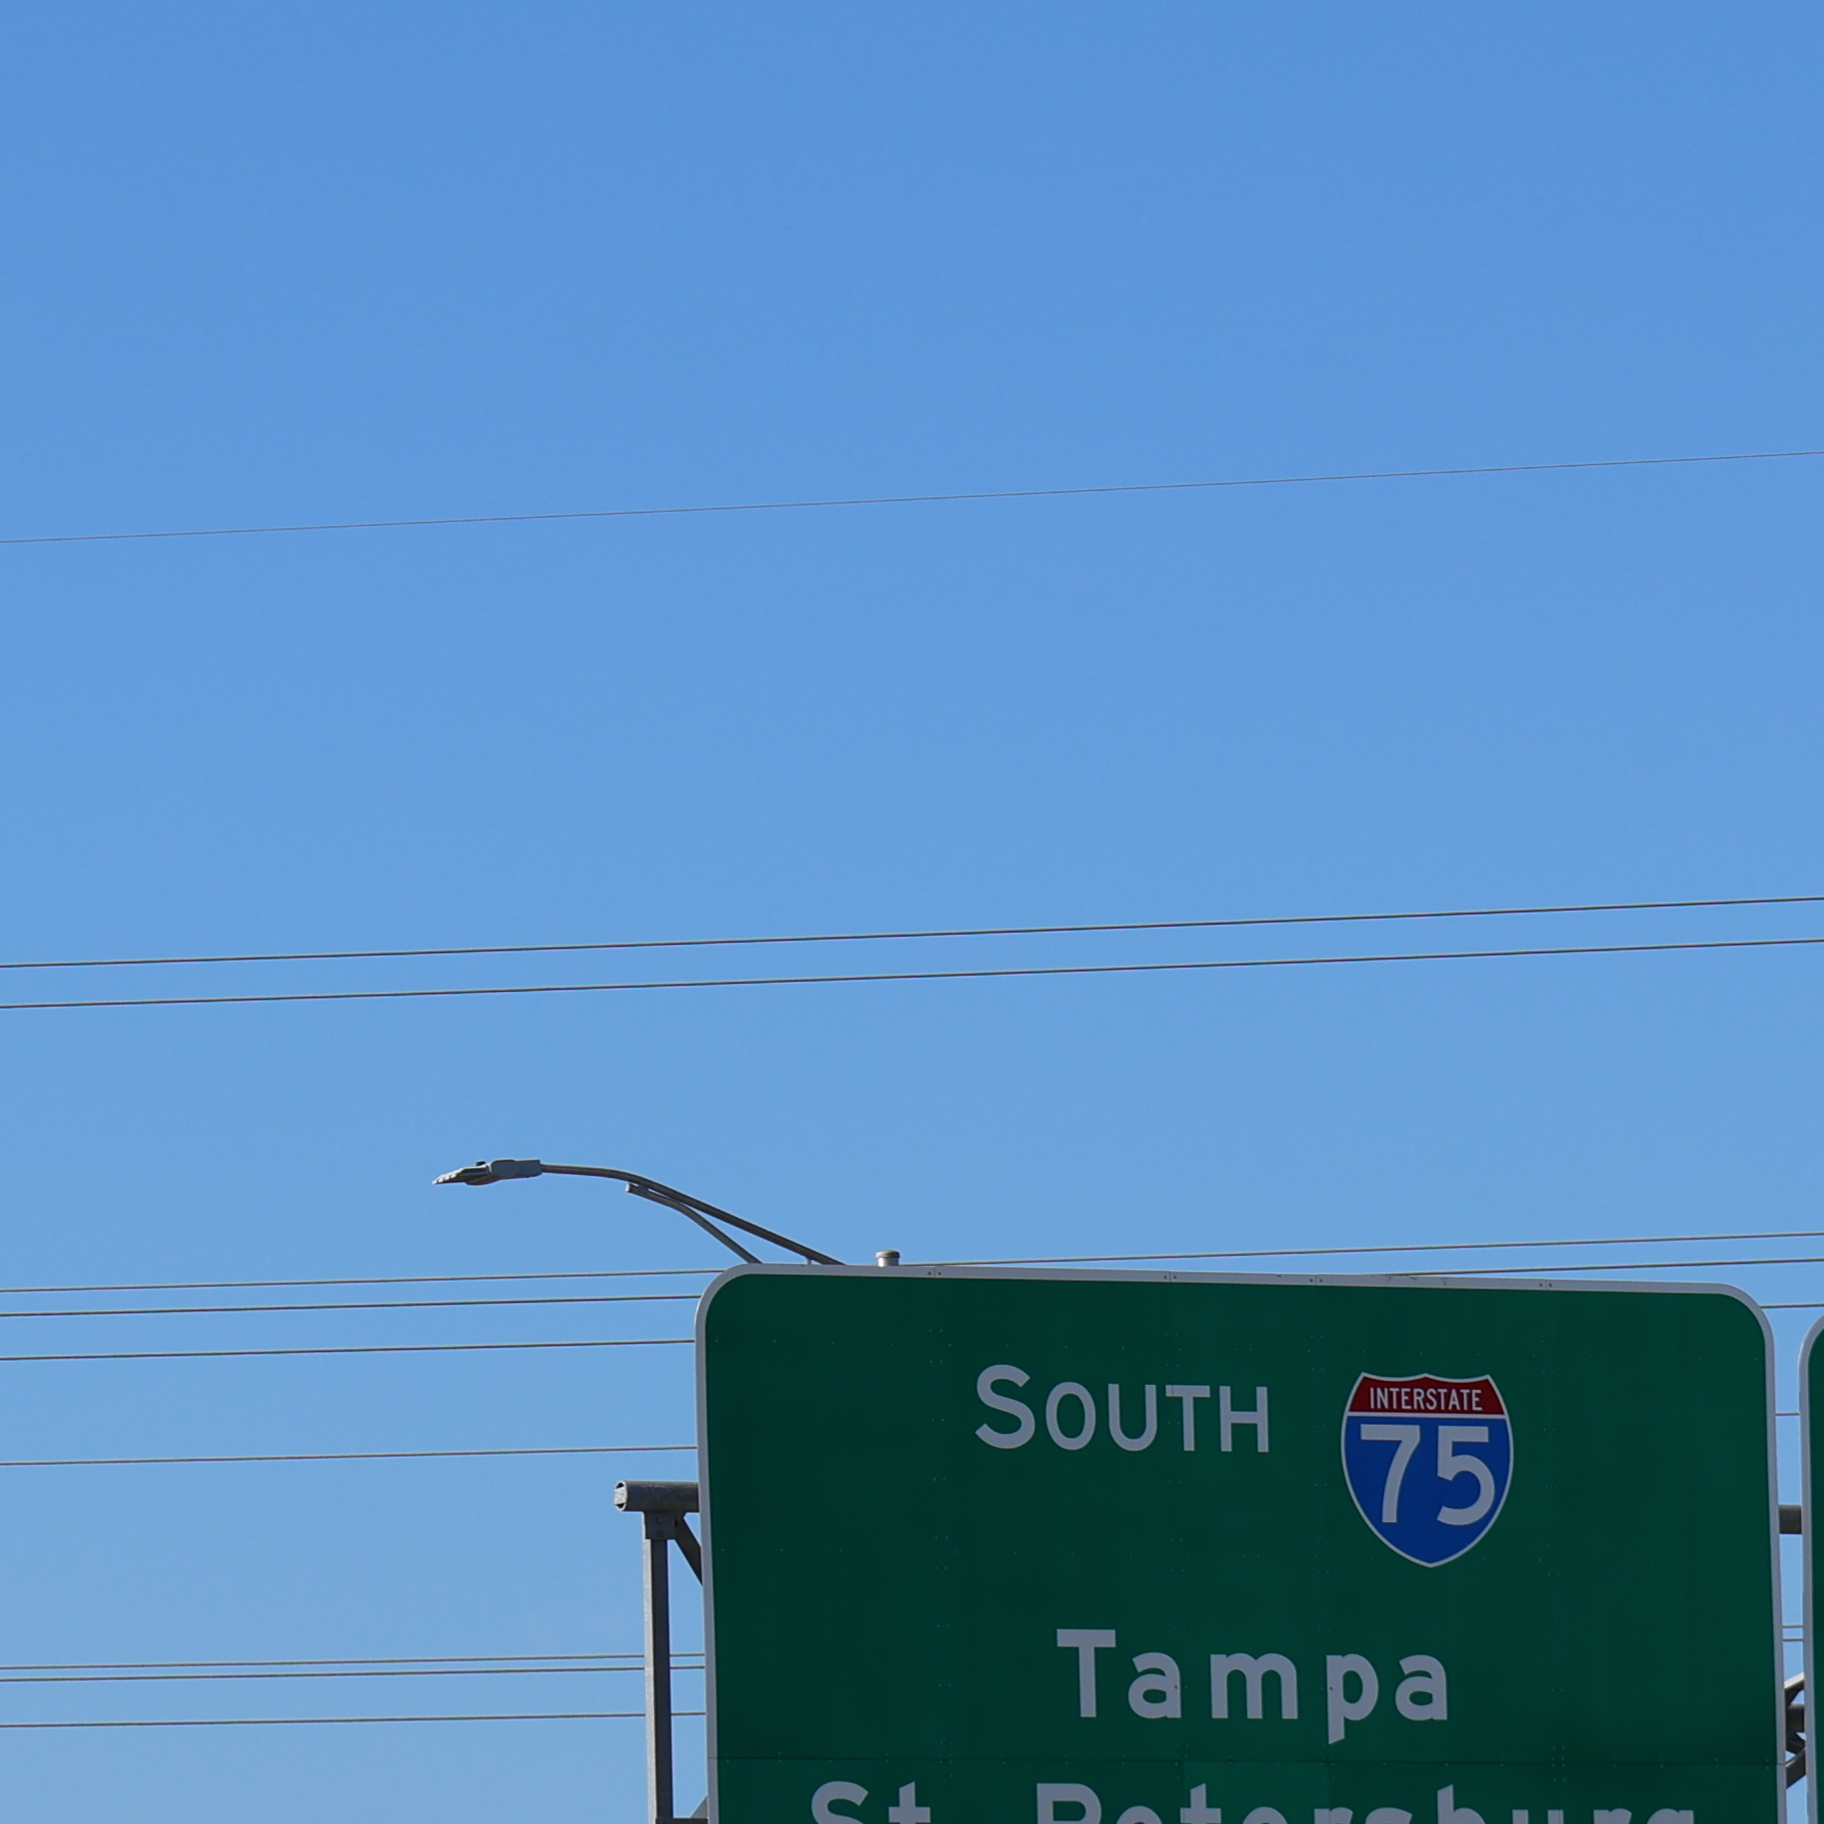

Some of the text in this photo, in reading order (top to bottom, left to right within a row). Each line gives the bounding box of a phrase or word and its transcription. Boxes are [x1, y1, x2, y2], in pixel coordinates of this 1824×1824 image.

[975, 1364, 1270, 1453] SOUTH
[1369, 1387, 1483, 1412] INTERSTATE
[1360, 1423, 1496, 1526] 75
[1056, 1628, 1449, 1745] Tampa
